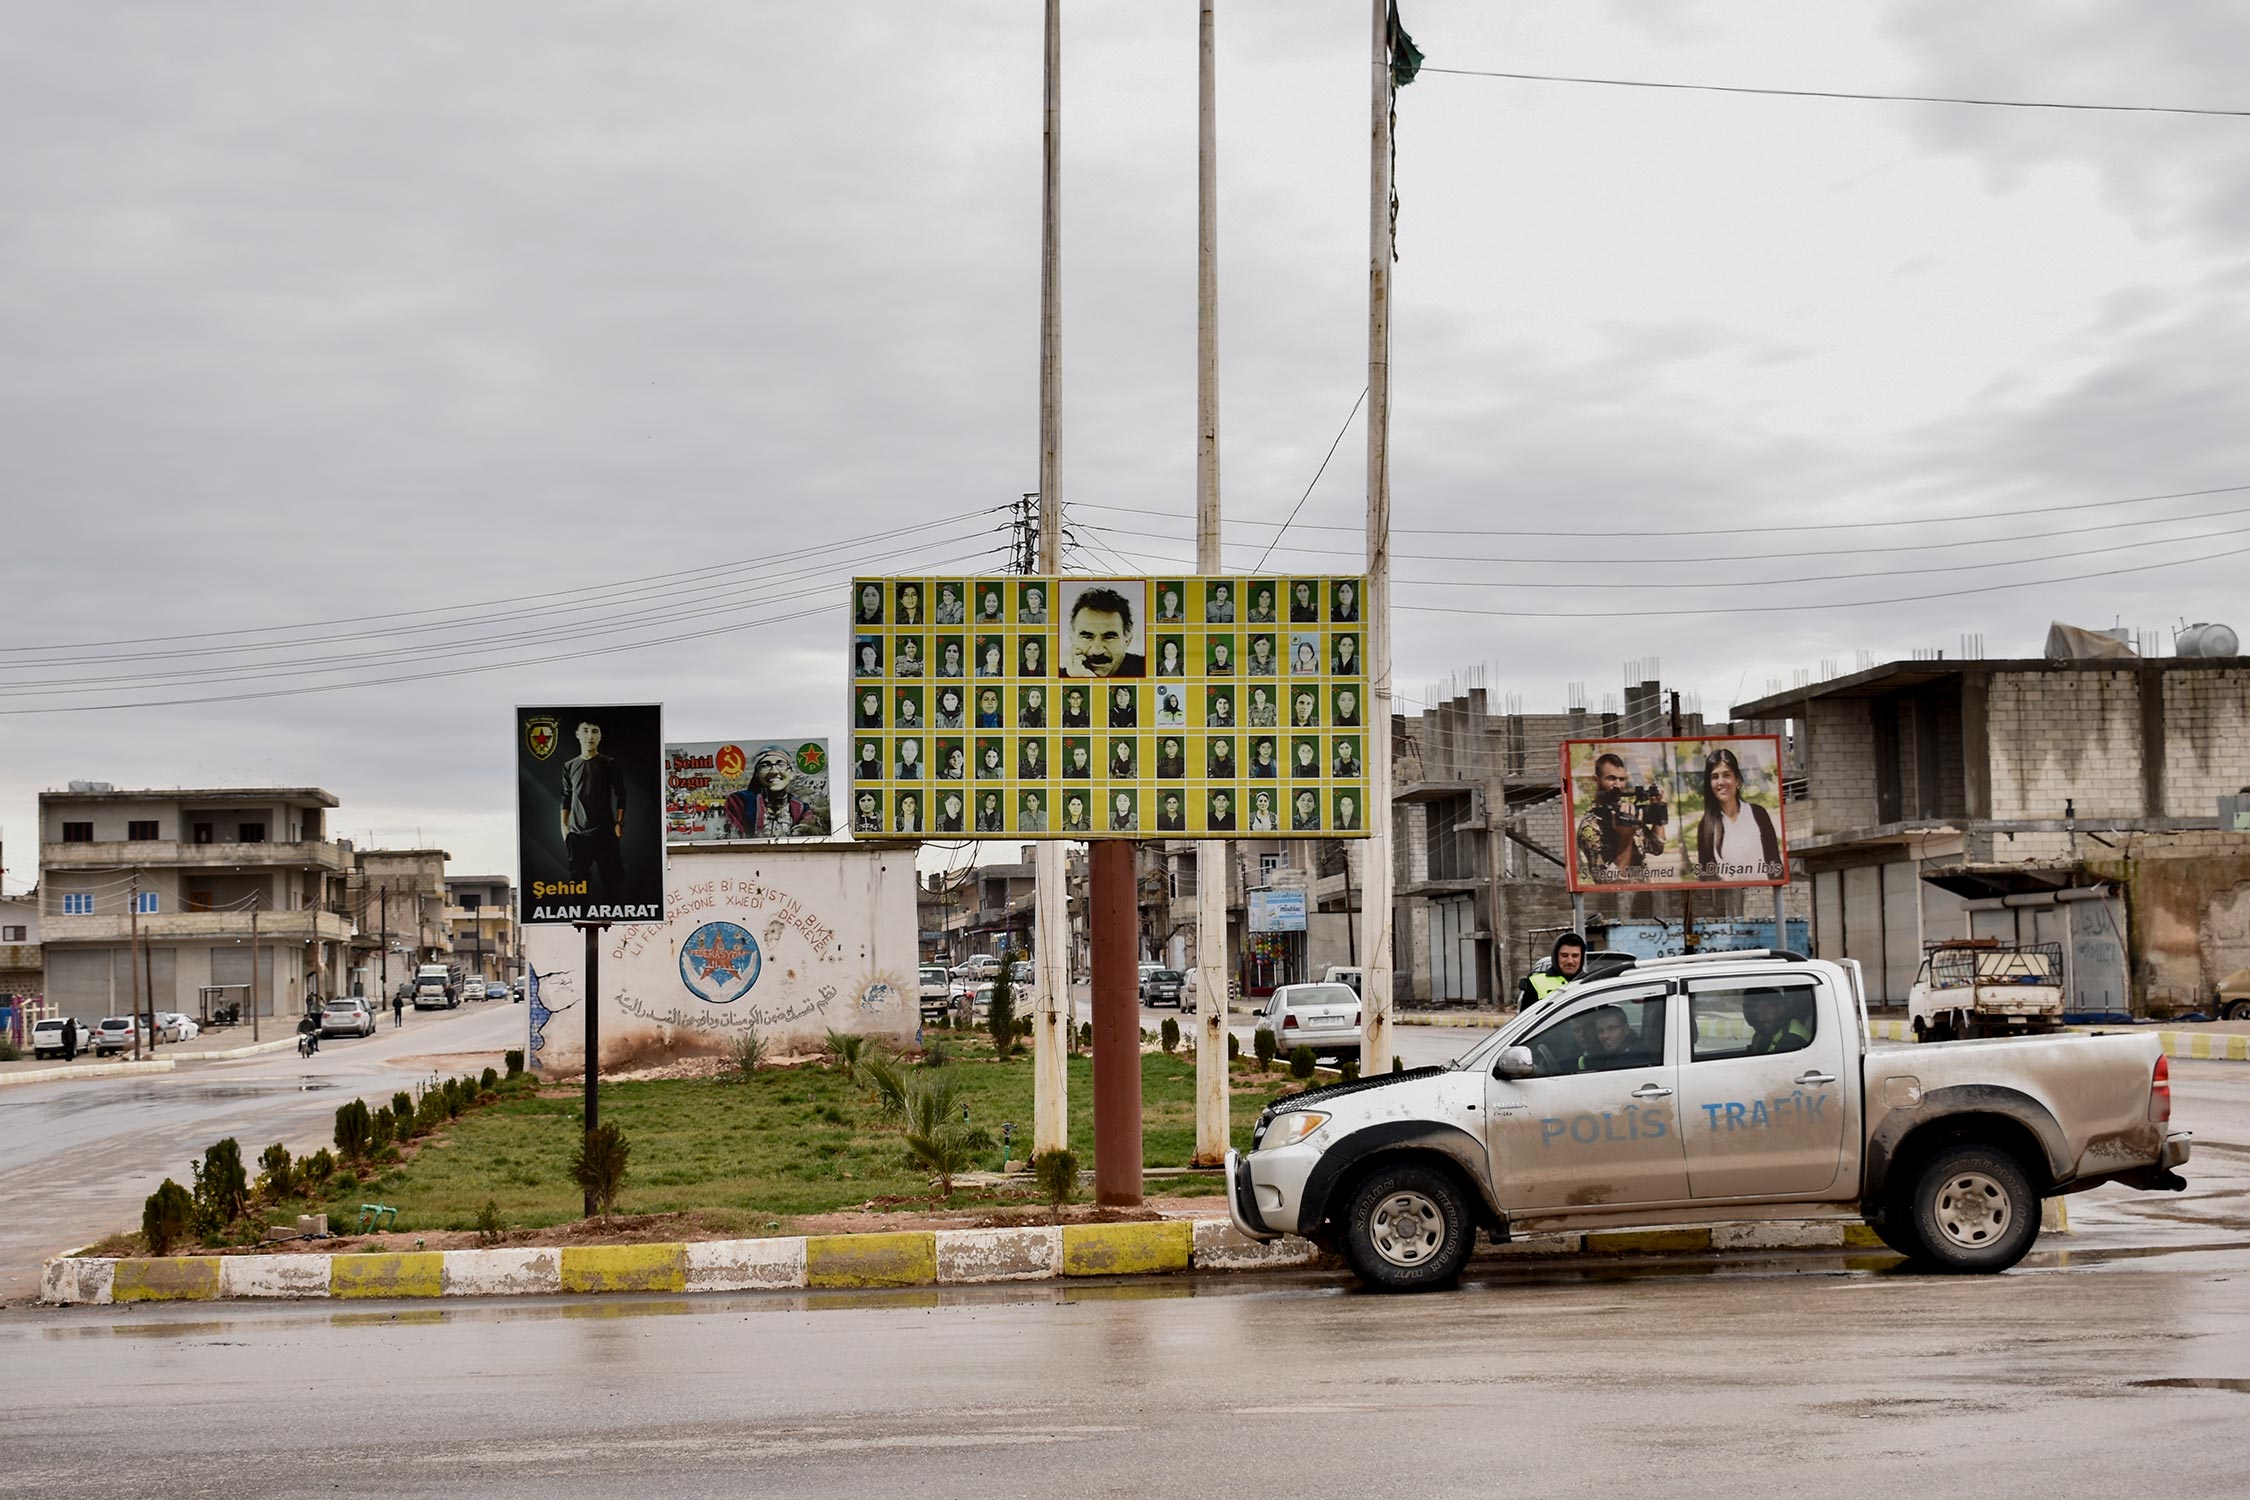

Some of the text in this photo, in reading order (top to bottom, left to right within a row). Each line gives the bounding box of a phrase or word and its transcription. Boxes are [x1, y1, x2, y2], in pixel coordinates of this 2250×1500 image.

[668, 771, 712, 791] Özgür
[532, 880, 588, 899] Şehîd
[666, 889, 682, 905] DE
[689, 881, 715, 895] XWE
[532, 904, 659, 919] ALAN ARARAT
[630, 943, 644, 957] LI
[1541, 1104, 1667, 1147] POLÎS
